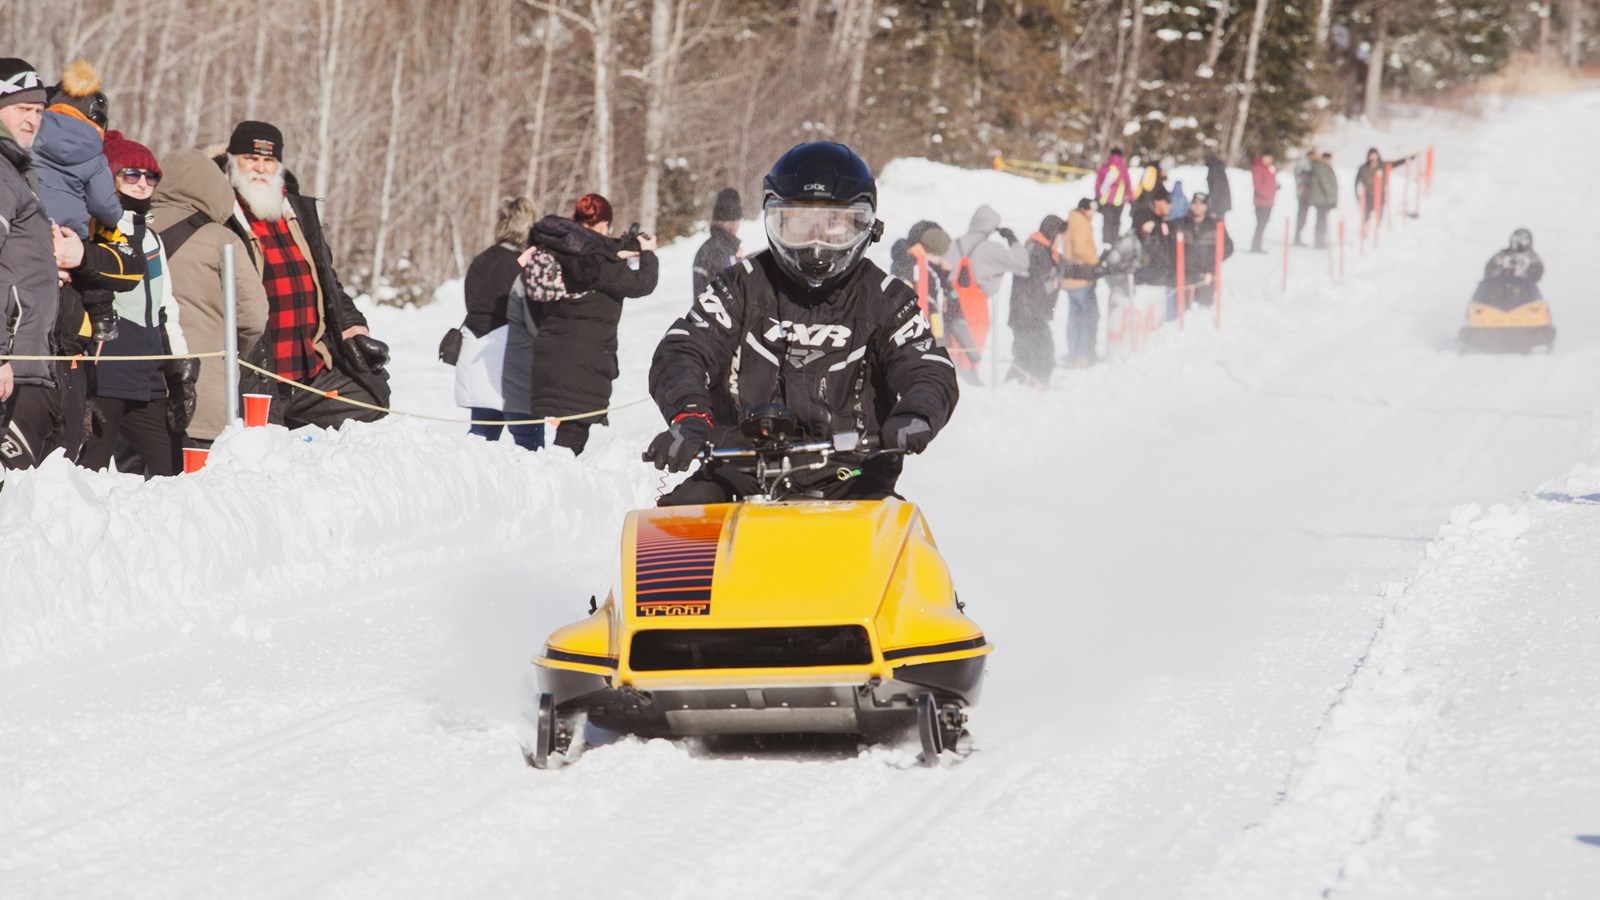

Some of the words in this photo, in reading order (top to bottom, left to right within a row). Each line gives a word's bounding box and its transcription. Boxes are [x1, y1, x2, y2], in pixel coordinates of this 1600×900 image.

[803, 183, 826, 191] CKX
[763, 317, 852, 347] FXR
[888, 309, 931, 347] FX
